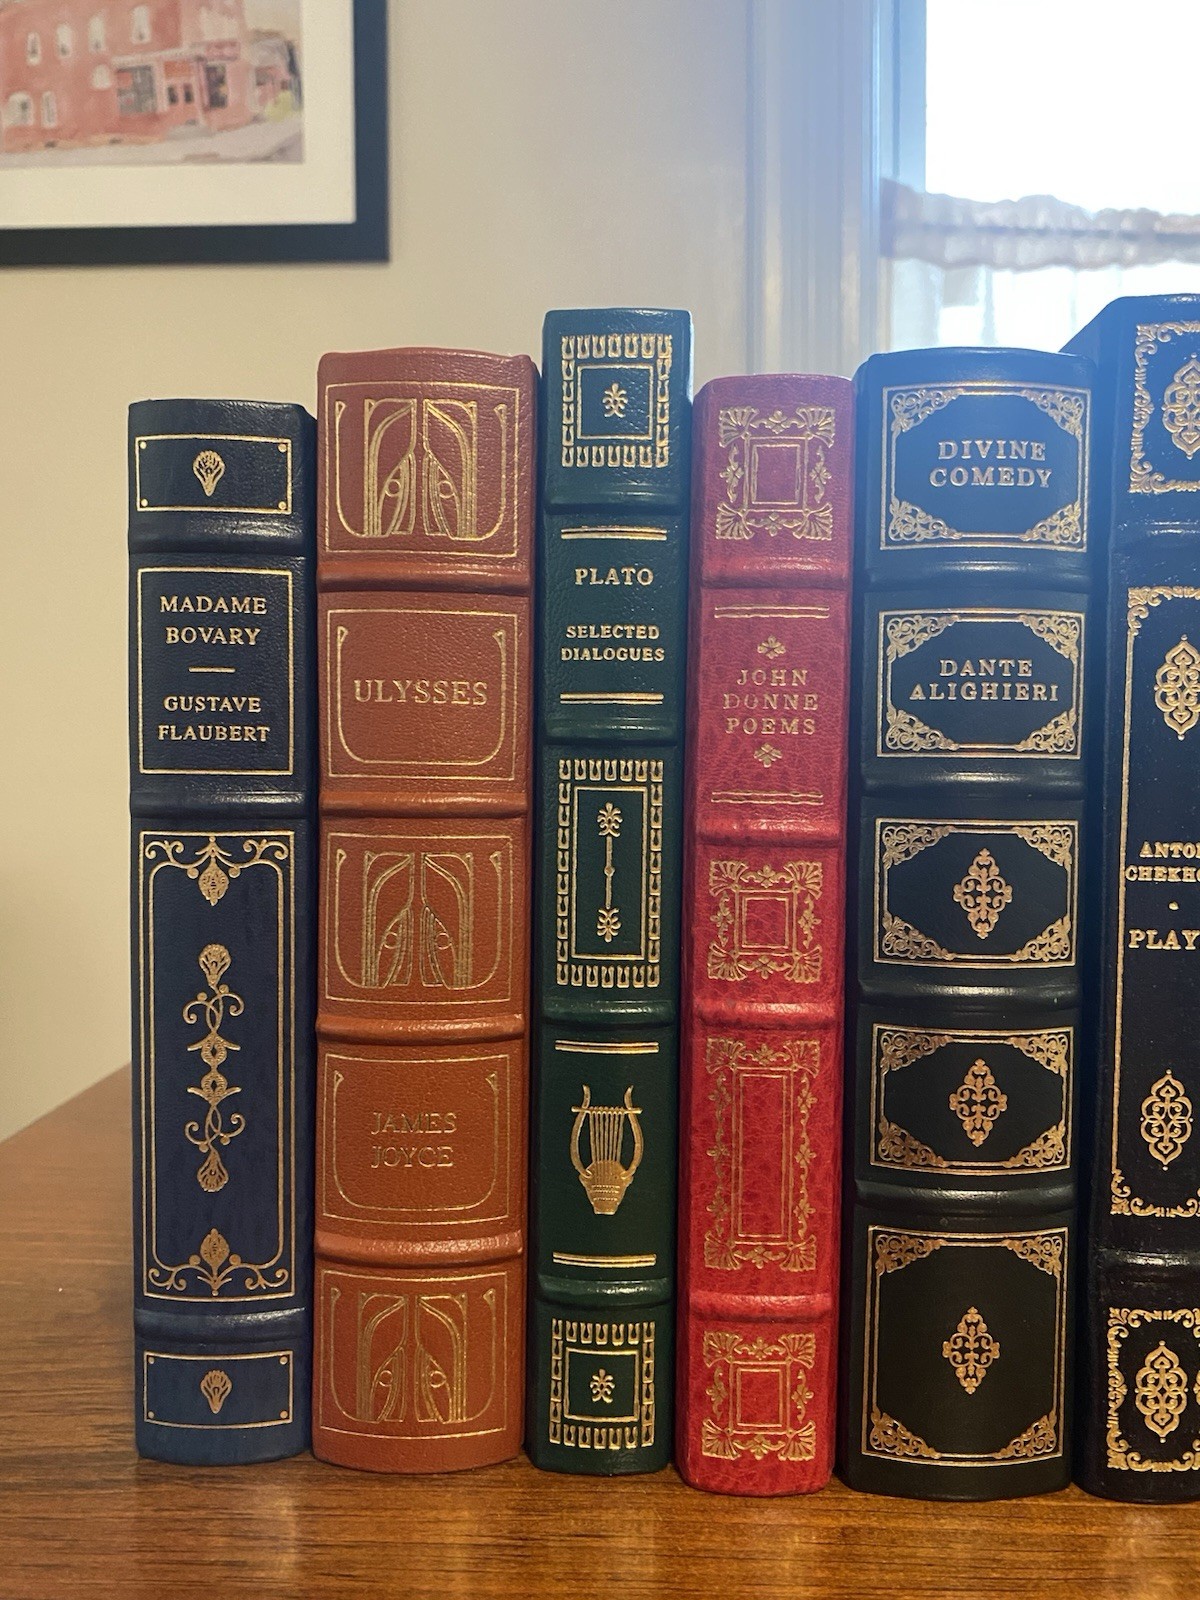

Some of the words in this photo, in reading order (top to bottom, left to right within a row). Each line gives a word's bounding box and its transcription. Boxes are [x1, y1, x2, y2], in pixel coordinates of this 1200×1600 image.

[938, 440, 1047, 461] DIVINE
[929, 466, 1052, 488] COMEDY
[574, 567, 654, 586] PLATO
[160, 595, 267, 615] MADAME
[165, 627, 261, 646] BOVARY
[565, 625, 660, 640] SELECTED
[561, 647, 665, 662] DIALOGUES
[939, 659, 1034, 677] DANTE
[736, 669, 809, 687] JOHN
[353, 679, 488, 706] ULYSSES
[909, 682, 1059, 702] ALIGHIERI
[163, 695, 262, 713] GUSTAVE
[722, 693, 819, 711] DONNE
[157, 725, 271, 743] FLAUBERT
[724, 717, 816, 735] POEMS
[370, 1112, 457, 1135] JAMES
[370, 1146, 455, 1169] JOYCE
